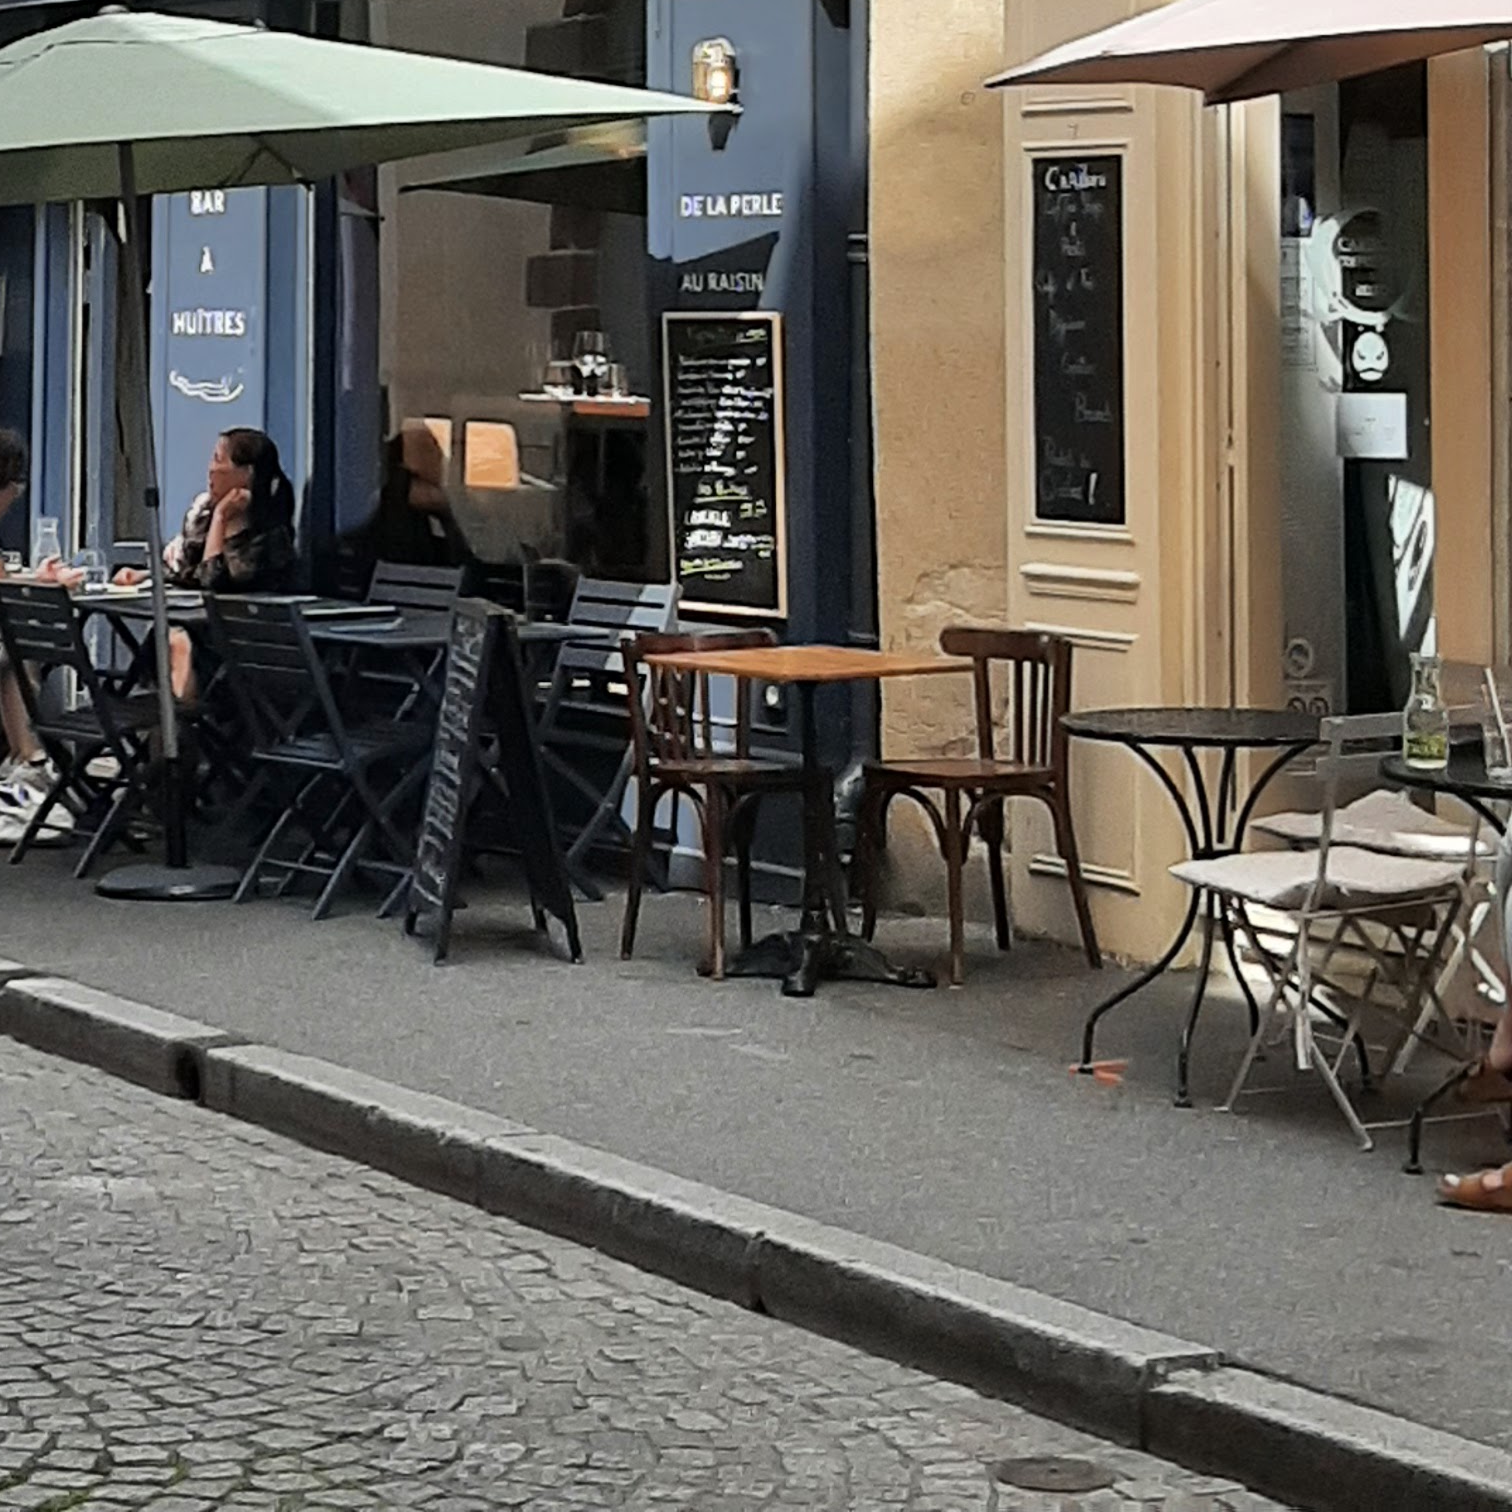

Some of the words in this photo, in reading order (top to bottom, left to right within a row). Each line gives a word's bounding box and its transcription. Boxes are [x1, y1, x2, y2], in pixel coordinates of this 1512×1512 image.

[190, 189, 226, 216] BAR
[680, 194, 705, 218] DE
[706, 194, 728, 217] LA
[729, 192, 784, 216] PERLE
[680, 271, 704, 293] AU
[707, 271, 766, 293] RAISIN
